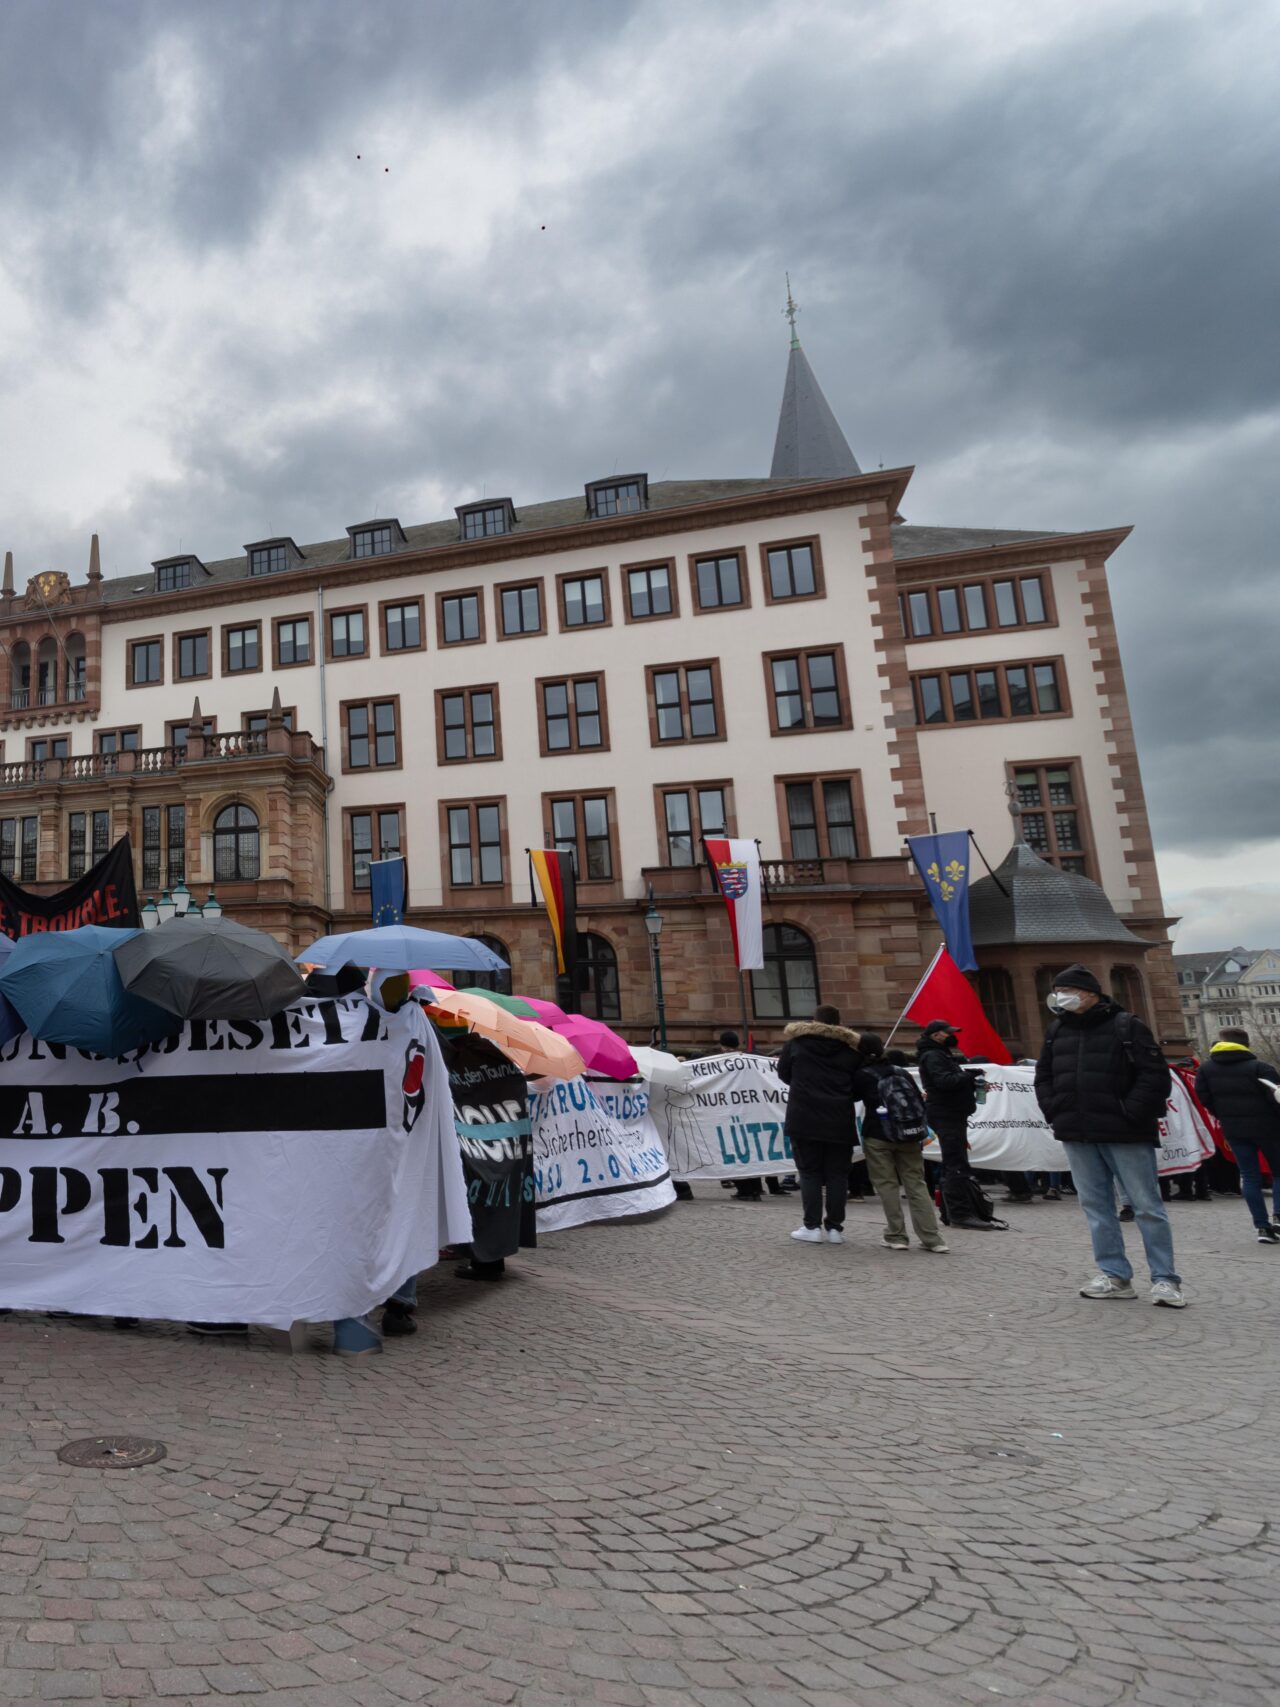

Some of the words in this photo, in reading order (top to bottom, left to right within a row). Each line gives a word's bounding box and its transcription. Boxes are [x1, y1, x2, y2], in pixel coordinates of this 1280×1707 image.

[692, 1061, 723, 1077] KEIN
[695, 1092, 728, 1107] NUR
[730, 1089, 760, 1104] DER
